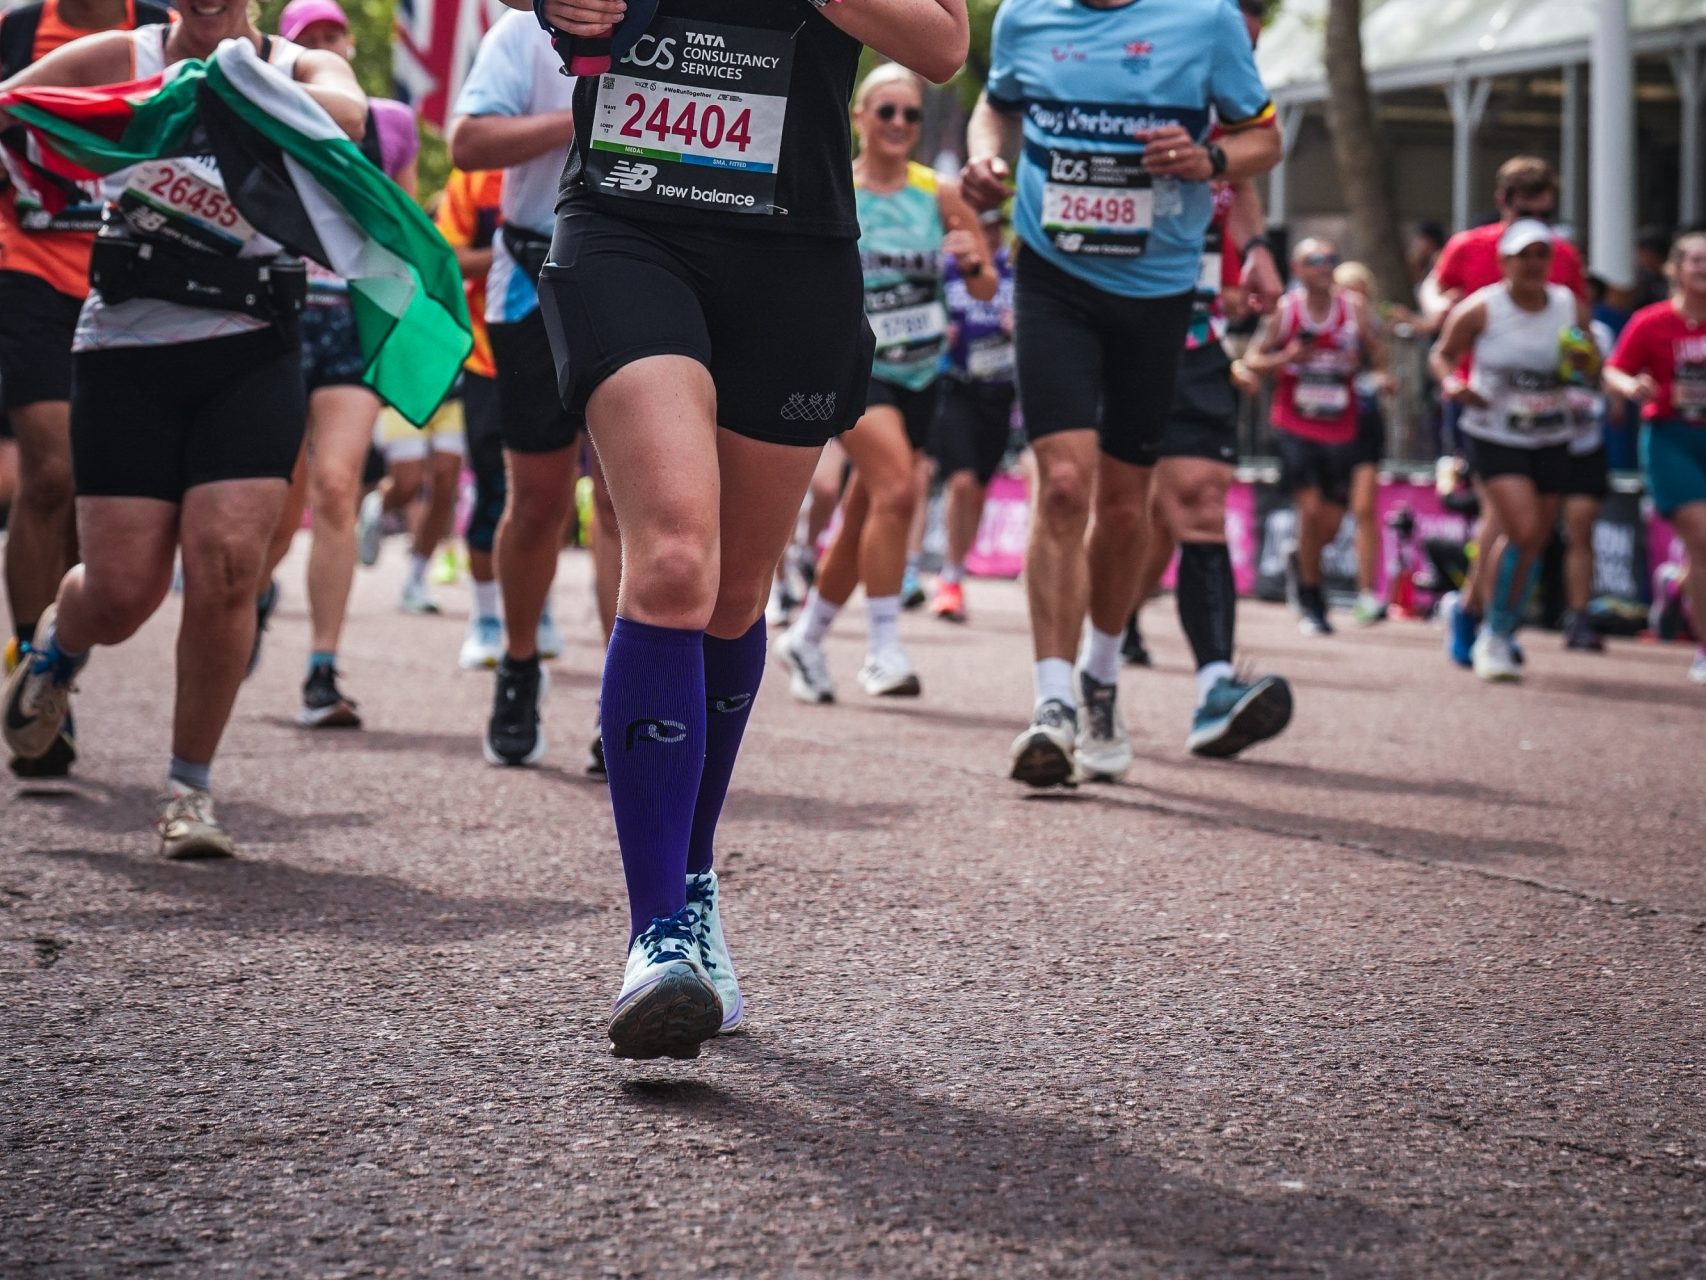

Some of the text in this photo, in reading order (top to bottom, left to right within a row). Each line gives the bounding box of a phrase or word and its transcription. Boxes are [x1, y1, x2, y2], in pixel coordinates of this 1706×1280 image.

[685, 31, 725, 48] TATA
[683, 47, 780, 69] CONSULTANCY
[680, 61, 743, 80] SERVICES
[664, 87, 712, 98] #WeRunTogether
[620, 93, 752, 152] 24404
[624, 146, 644, 154] MEDAL
[150, 166, 238, 227] 26455
[656, 183, 755, 207] new balance
[1061, 195, 1135, 224] 26498
